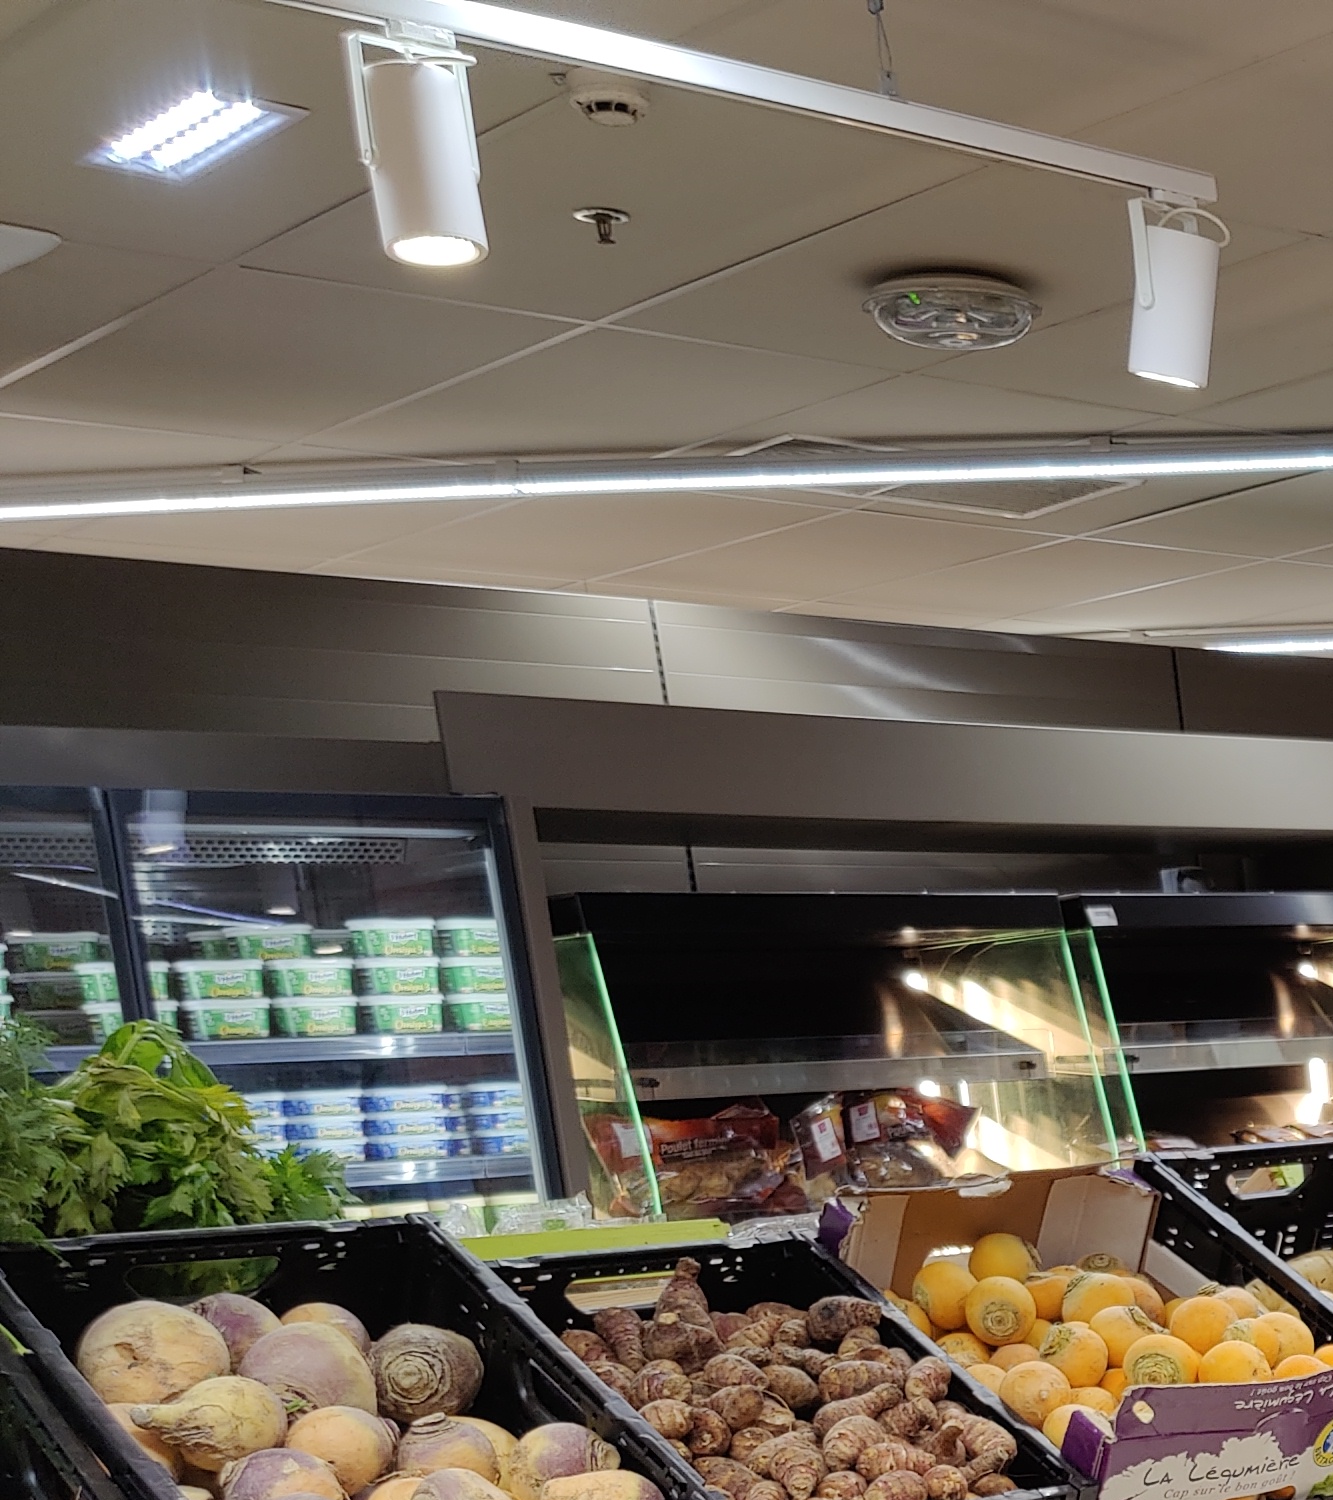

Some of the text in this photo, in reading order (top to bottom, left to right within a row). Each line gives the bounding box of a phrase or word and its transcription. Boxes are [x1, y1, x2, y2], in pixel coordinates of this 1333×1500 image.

[660, 1140, 692, 1155] Poulet
[1164, 1489, 1189, 1500] Cap
[1193, 1486, 1216, 1496] sur
[1234, 1479, 1258, 1492] bon
